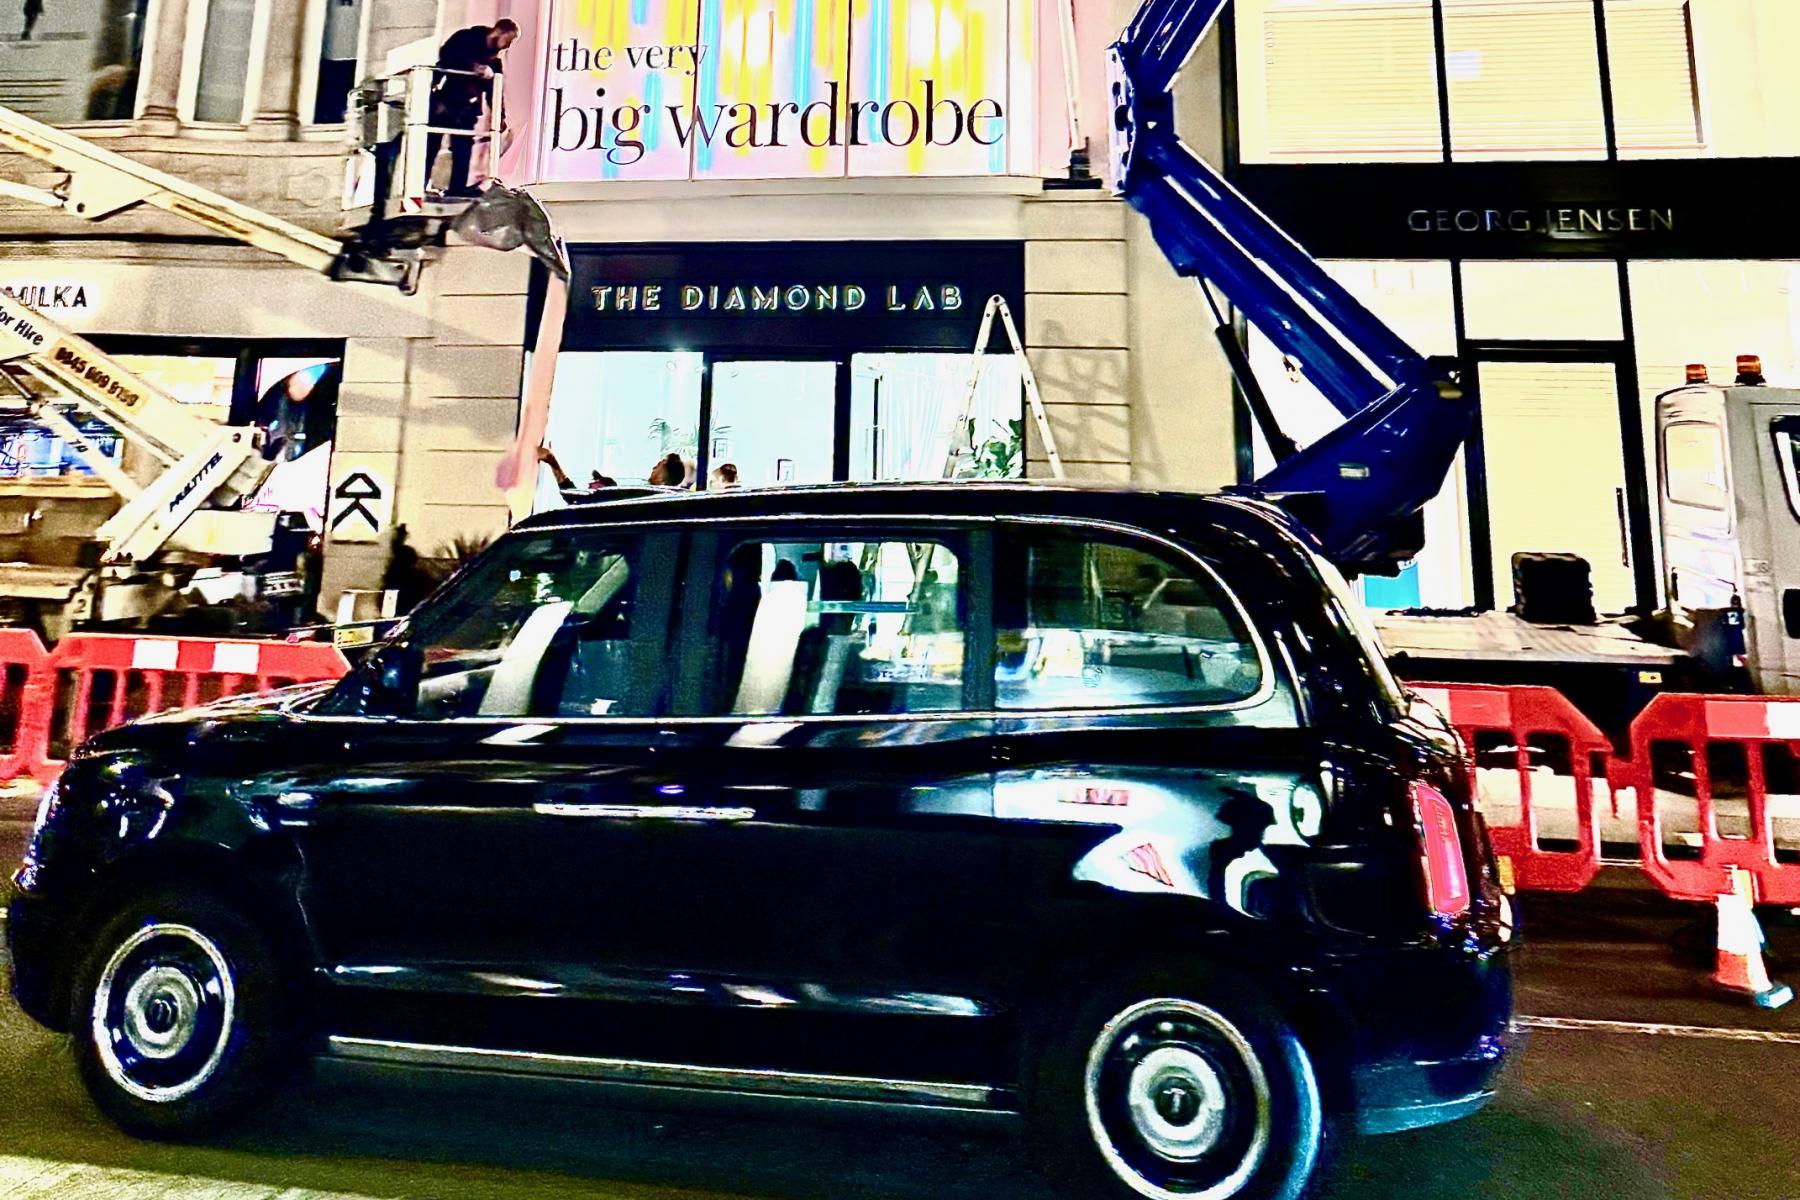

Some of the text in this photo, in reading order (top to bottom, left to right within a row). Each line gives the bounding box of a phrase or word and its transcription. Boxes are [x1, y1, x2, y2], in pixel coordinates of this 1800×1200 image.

[553, 38, 708, 76] the very
[550, 79, 1005, 165] big wardrobe
[1408, 208, 1673, 234] GEORG JENSEN
[592, 284, 963, 311] THE DIAMOND LAB
[13, 319, 44, 346] Hire
